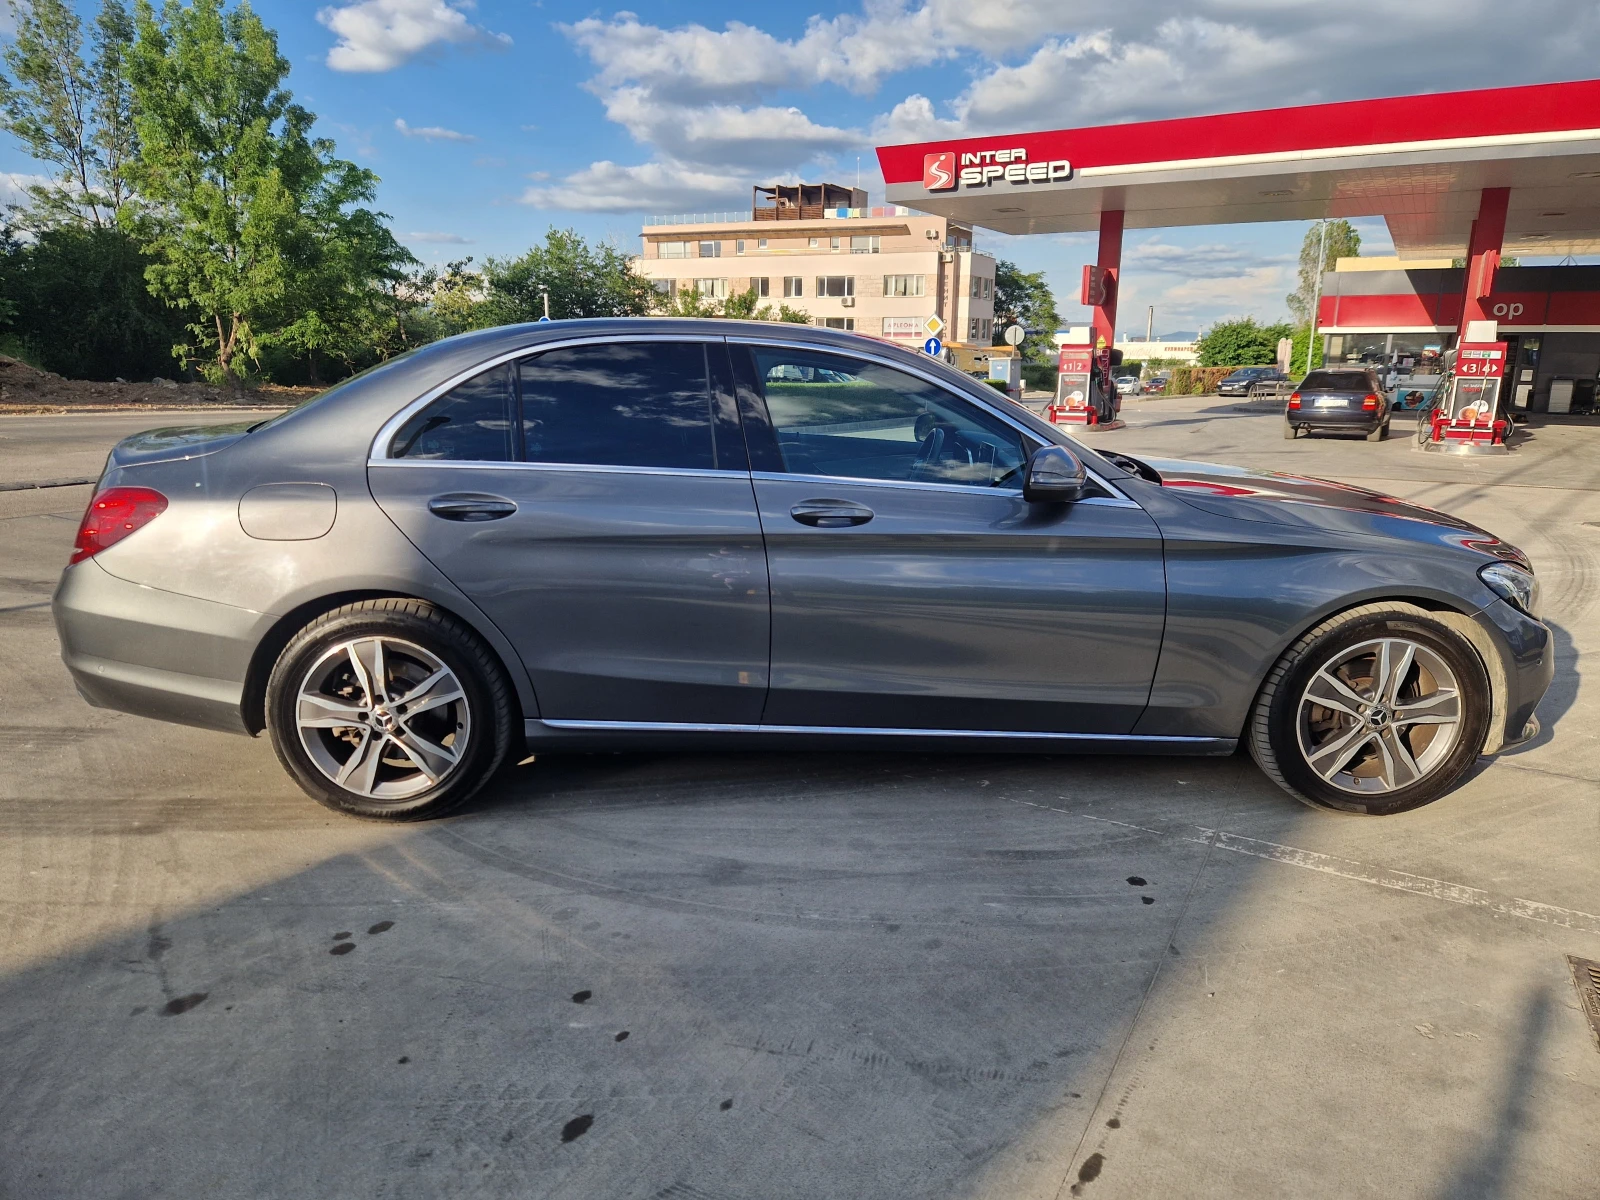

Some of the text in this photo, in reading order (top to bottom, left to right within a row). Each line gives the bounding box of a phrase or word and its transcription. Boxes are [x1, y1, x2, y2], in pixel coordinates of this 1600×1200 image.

[961, 148, 1027, 166] INTER
[960, 160, 1071, 185] SPEED
[1076, 362, 1082, 370] 2
[1468, 363, 1490, 373] 3 4
